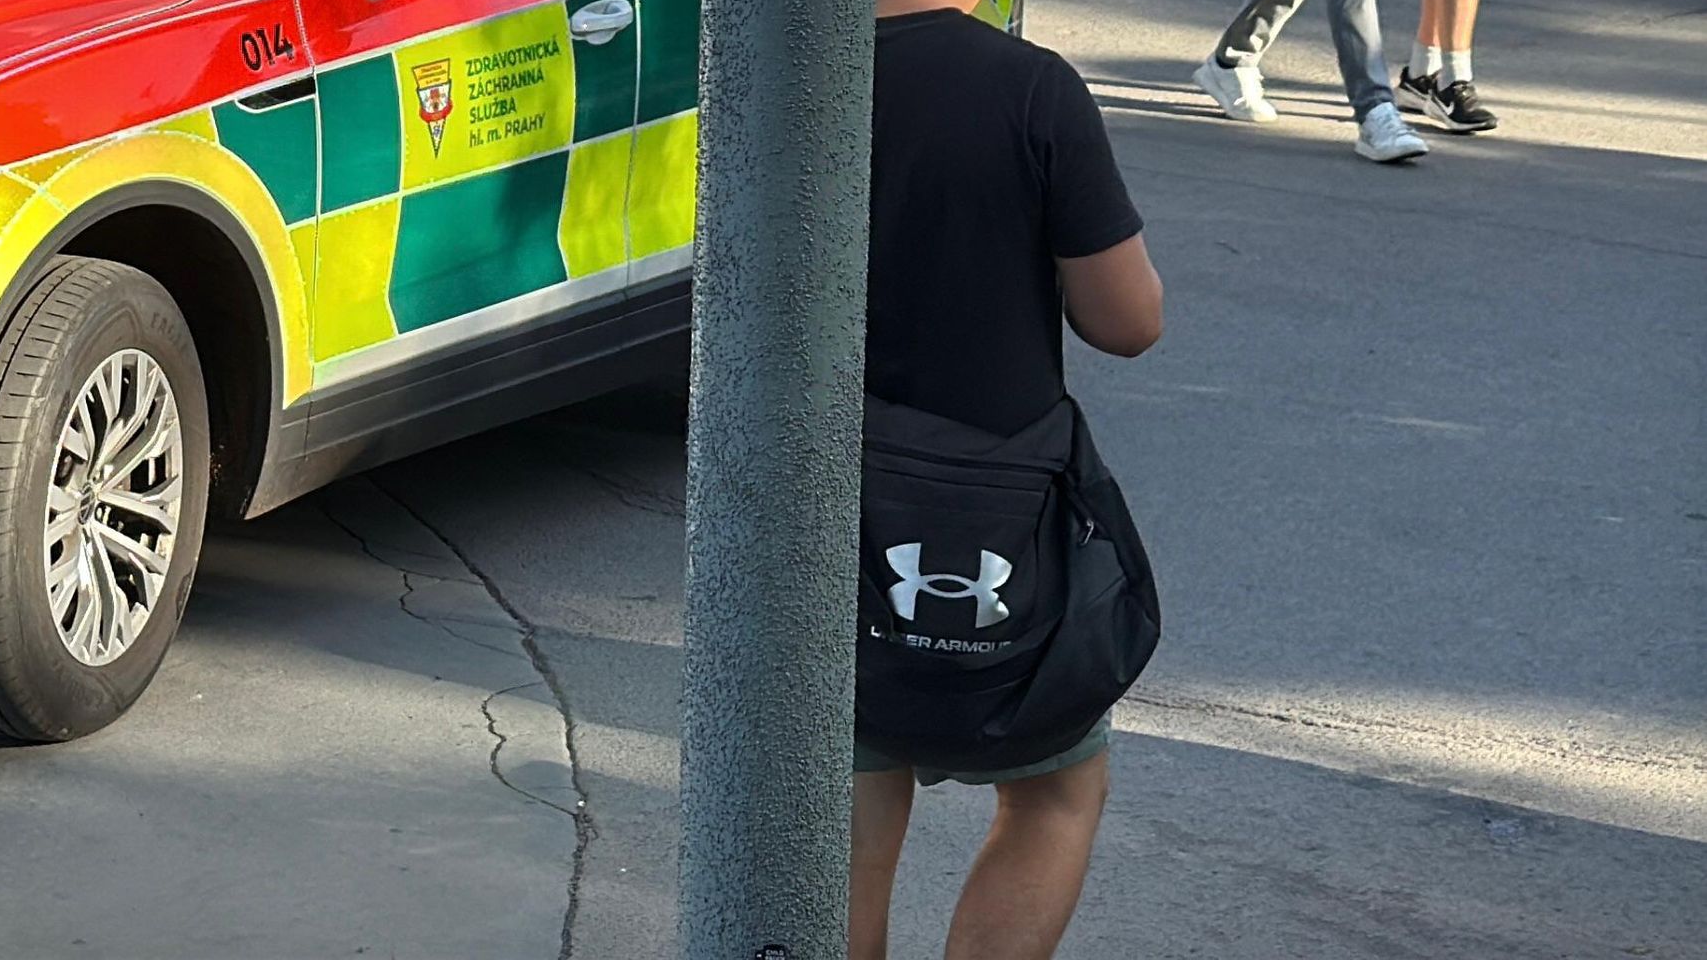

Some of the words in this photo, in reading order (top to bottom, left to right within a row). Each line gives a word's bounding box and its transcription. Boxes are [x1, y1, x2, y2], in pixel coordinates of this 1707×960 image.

[241, 23, 295, 71] 014
[465, 34, 560, 77] ZDRAVOTNICKÁ
[468, 66, 545, 101] ZÁCHRANNÁ
[469, 96, 517, 124] SLUŽBA
[505, 113, 546, 139] PRAHY
[870, 625, 931, 649] UER
